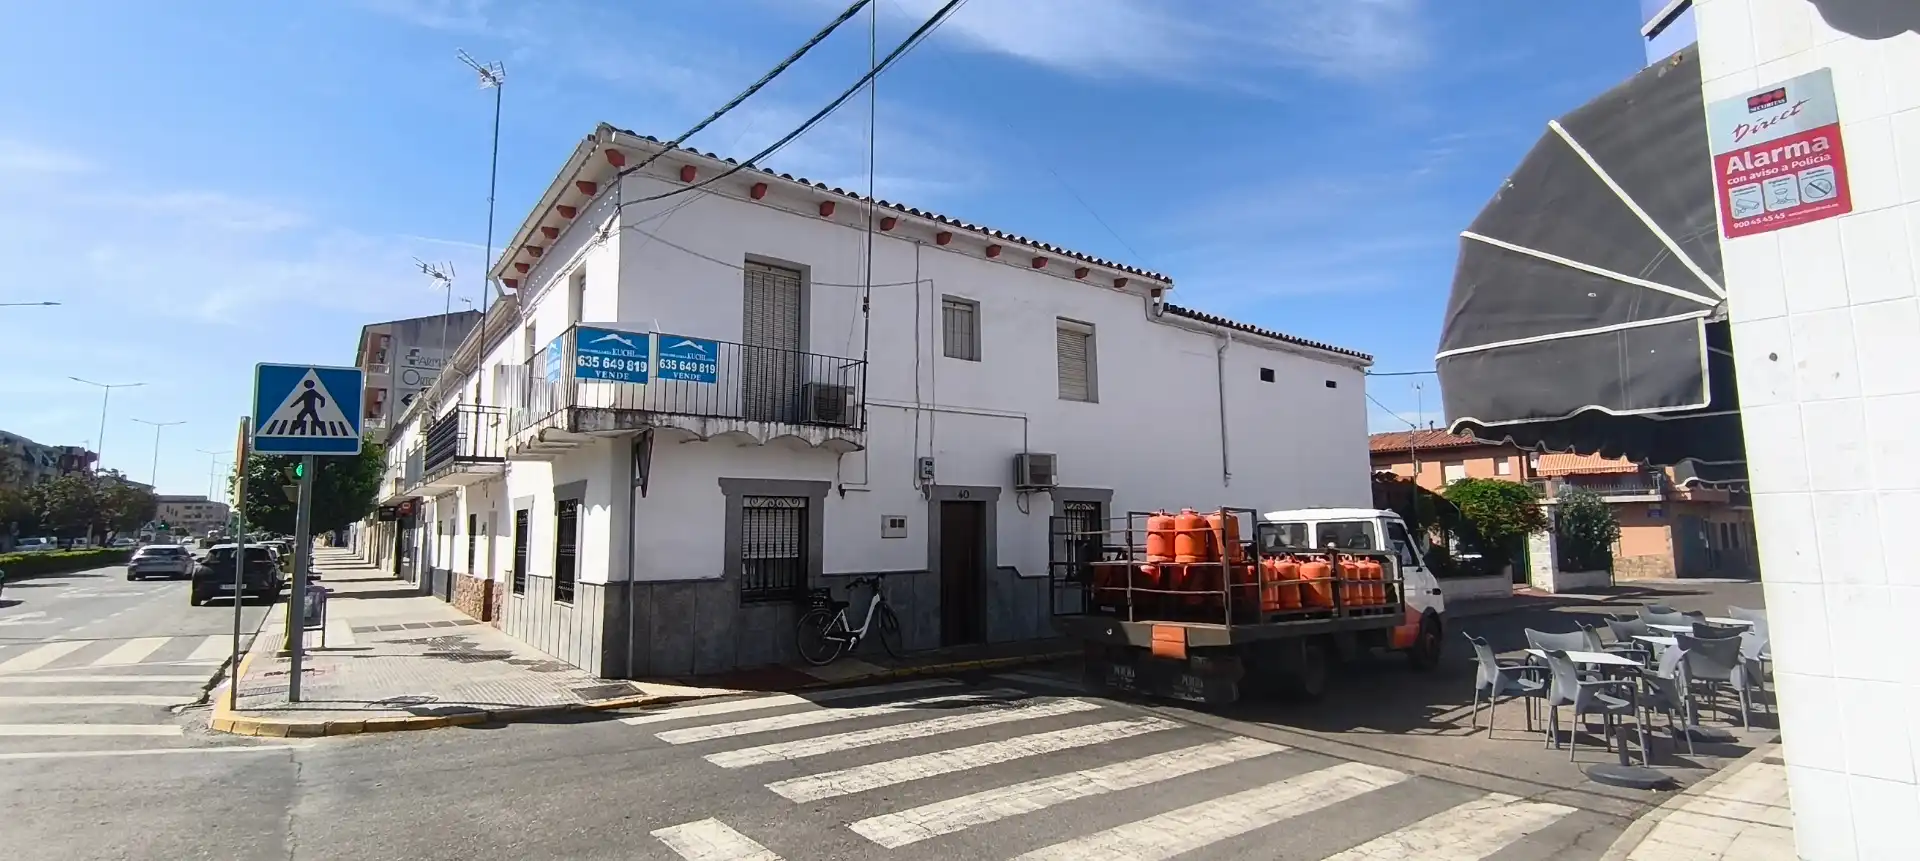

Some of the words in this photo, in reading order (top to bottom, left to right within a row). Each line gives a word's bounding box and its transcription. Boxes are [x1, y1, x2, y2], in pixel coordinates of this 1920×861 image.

[1732, 98, 1812, 143] Direct
[1726, 135, 1830, 175] Alarma
[1727, 175, 1747, 185] con
[1750, 167, 1779, 180] aviso
[1781, 164, 1789, 172] a
[1733, 220, 1750, 229] 900
[1751, 217, 1762, 225] 45
[1774, 212, 1785, 220] 45
[577, 354, 600, 368] 635
[602, 357, 625, 370] 649
[626, 359, 647, 373] 819
[659, 358, 677, 370] 635
[679, 360, 697, 372] 649
[699, 362, 716, 374] 819
[595, 370, 630, 381] VENDE
[673, 371, 701, 381] VENDE
[957, 490, 969, 499] 40
